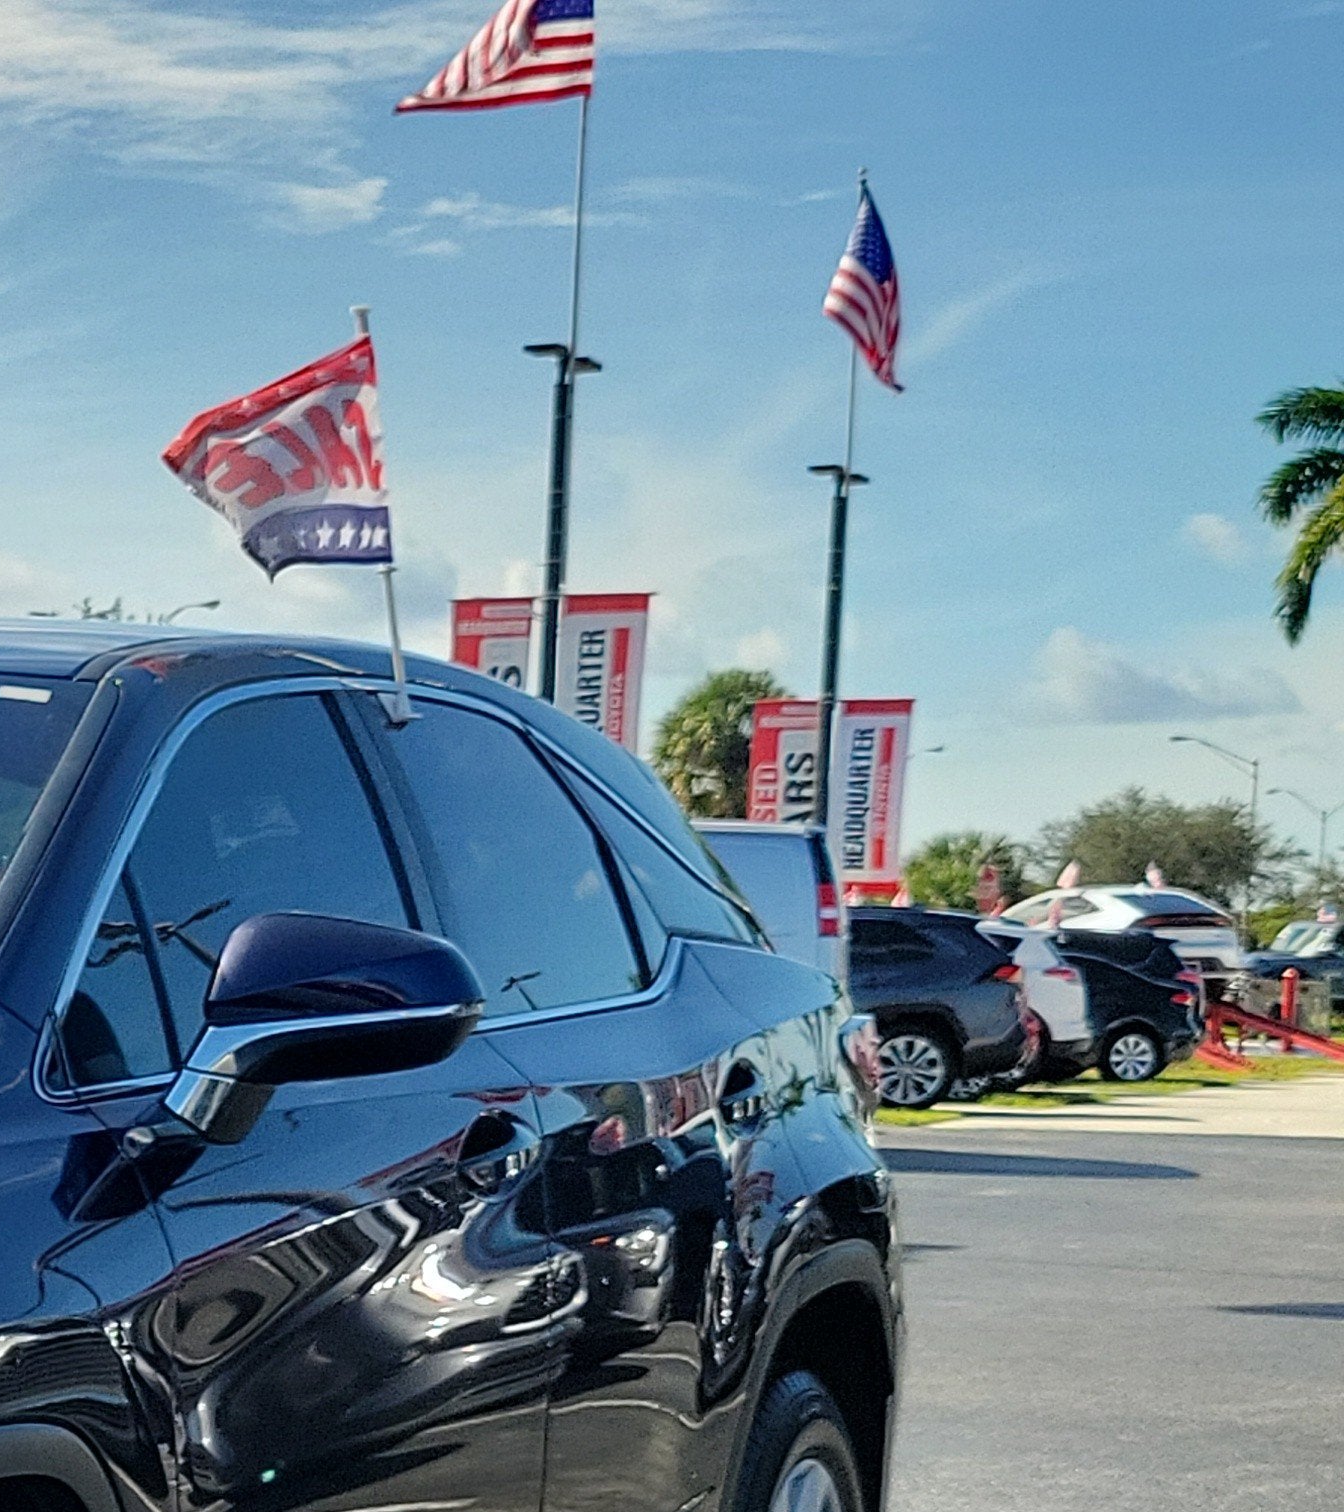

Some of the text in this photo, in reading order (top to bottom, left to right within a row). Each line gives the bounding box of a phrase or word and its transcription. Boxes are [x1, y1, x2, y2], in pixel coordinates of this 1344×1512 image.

[575, 629, 606, 732] UARTER
[751, 763, 778, 822] SED
[781, 753, 815, 824] ARS
[842, 727, 875, 869] HEADQUARTER
